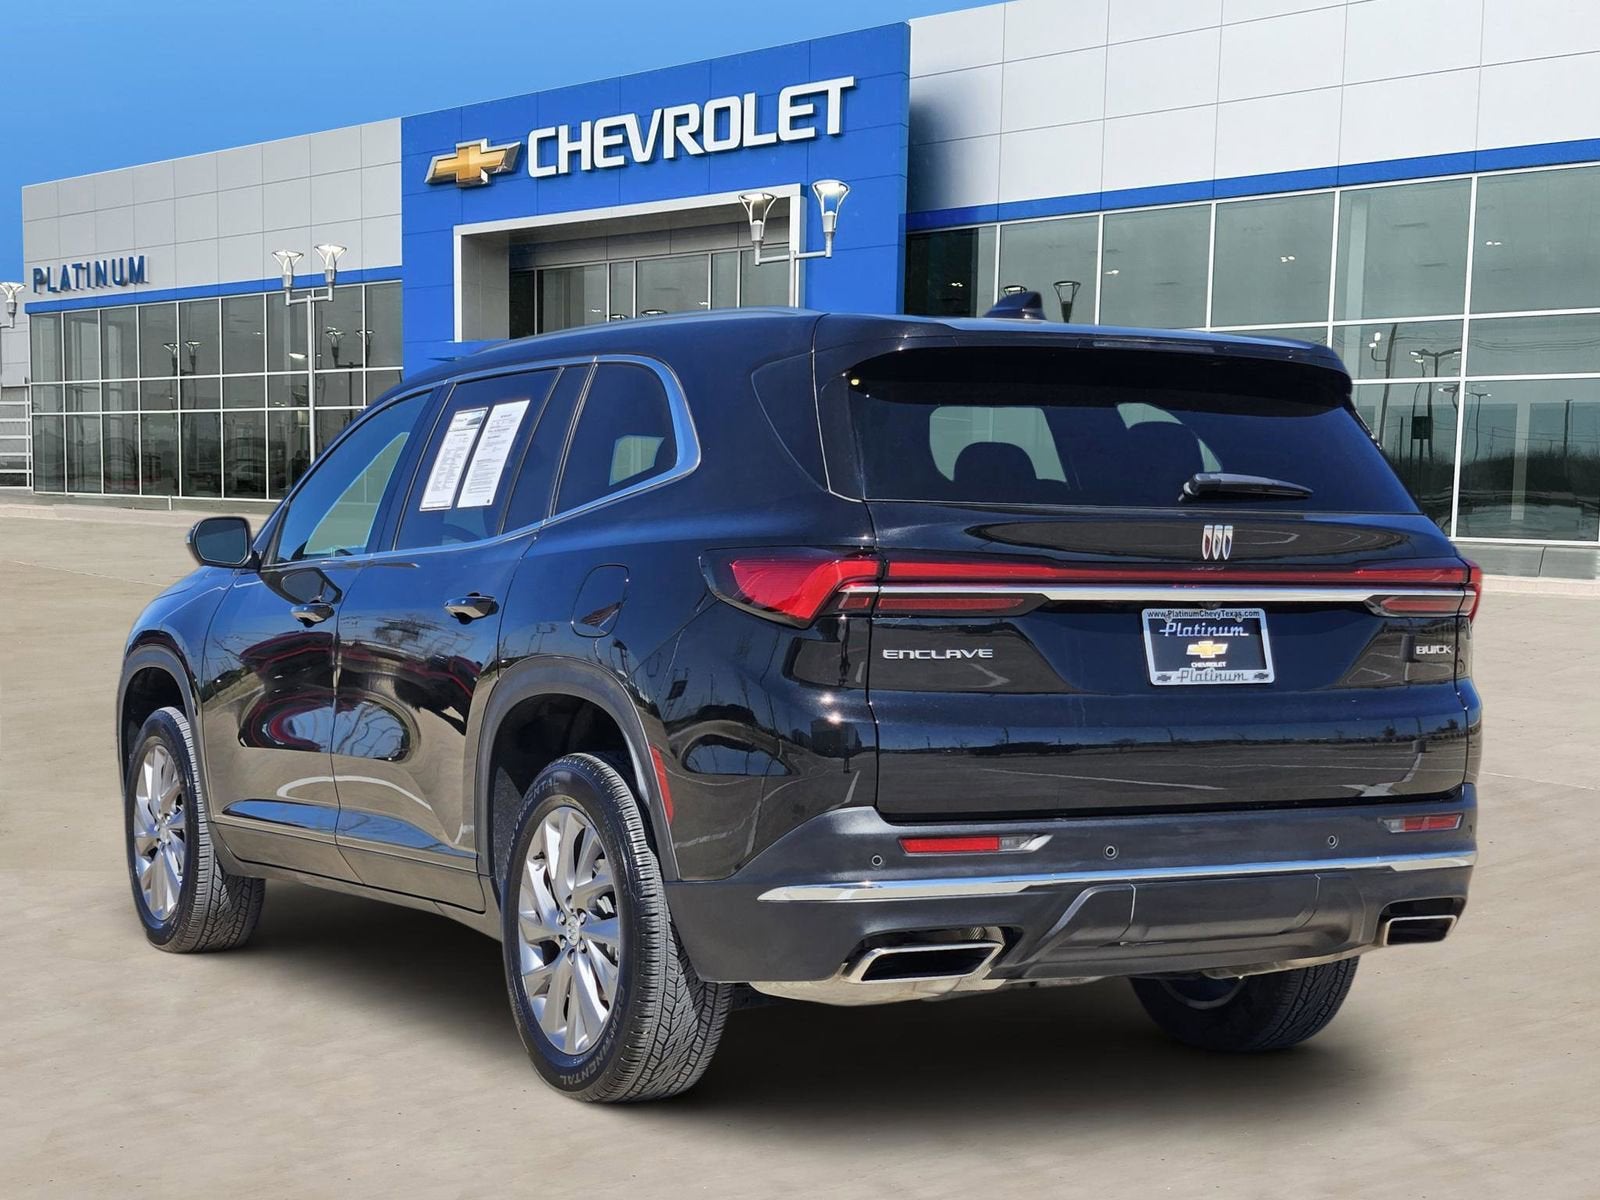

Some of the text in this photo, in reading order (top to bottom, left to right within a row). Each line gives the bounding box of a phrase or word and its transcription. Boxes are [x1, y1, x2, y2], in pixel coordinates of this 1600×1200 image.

[527, 76, 855, 178] CHEVROLET
[33, 255, 146, 294] PLATINUM
[1147, 609, 1260, 619] www.PlatinumChevyTexas.com
[1159, 622, 1249, 637] Platinum
[882, 649, 993, 659] ENCLAVE
[1415, 645, 1452, 655] BUICK
[1177, 668, 1248, 682] Platinum
